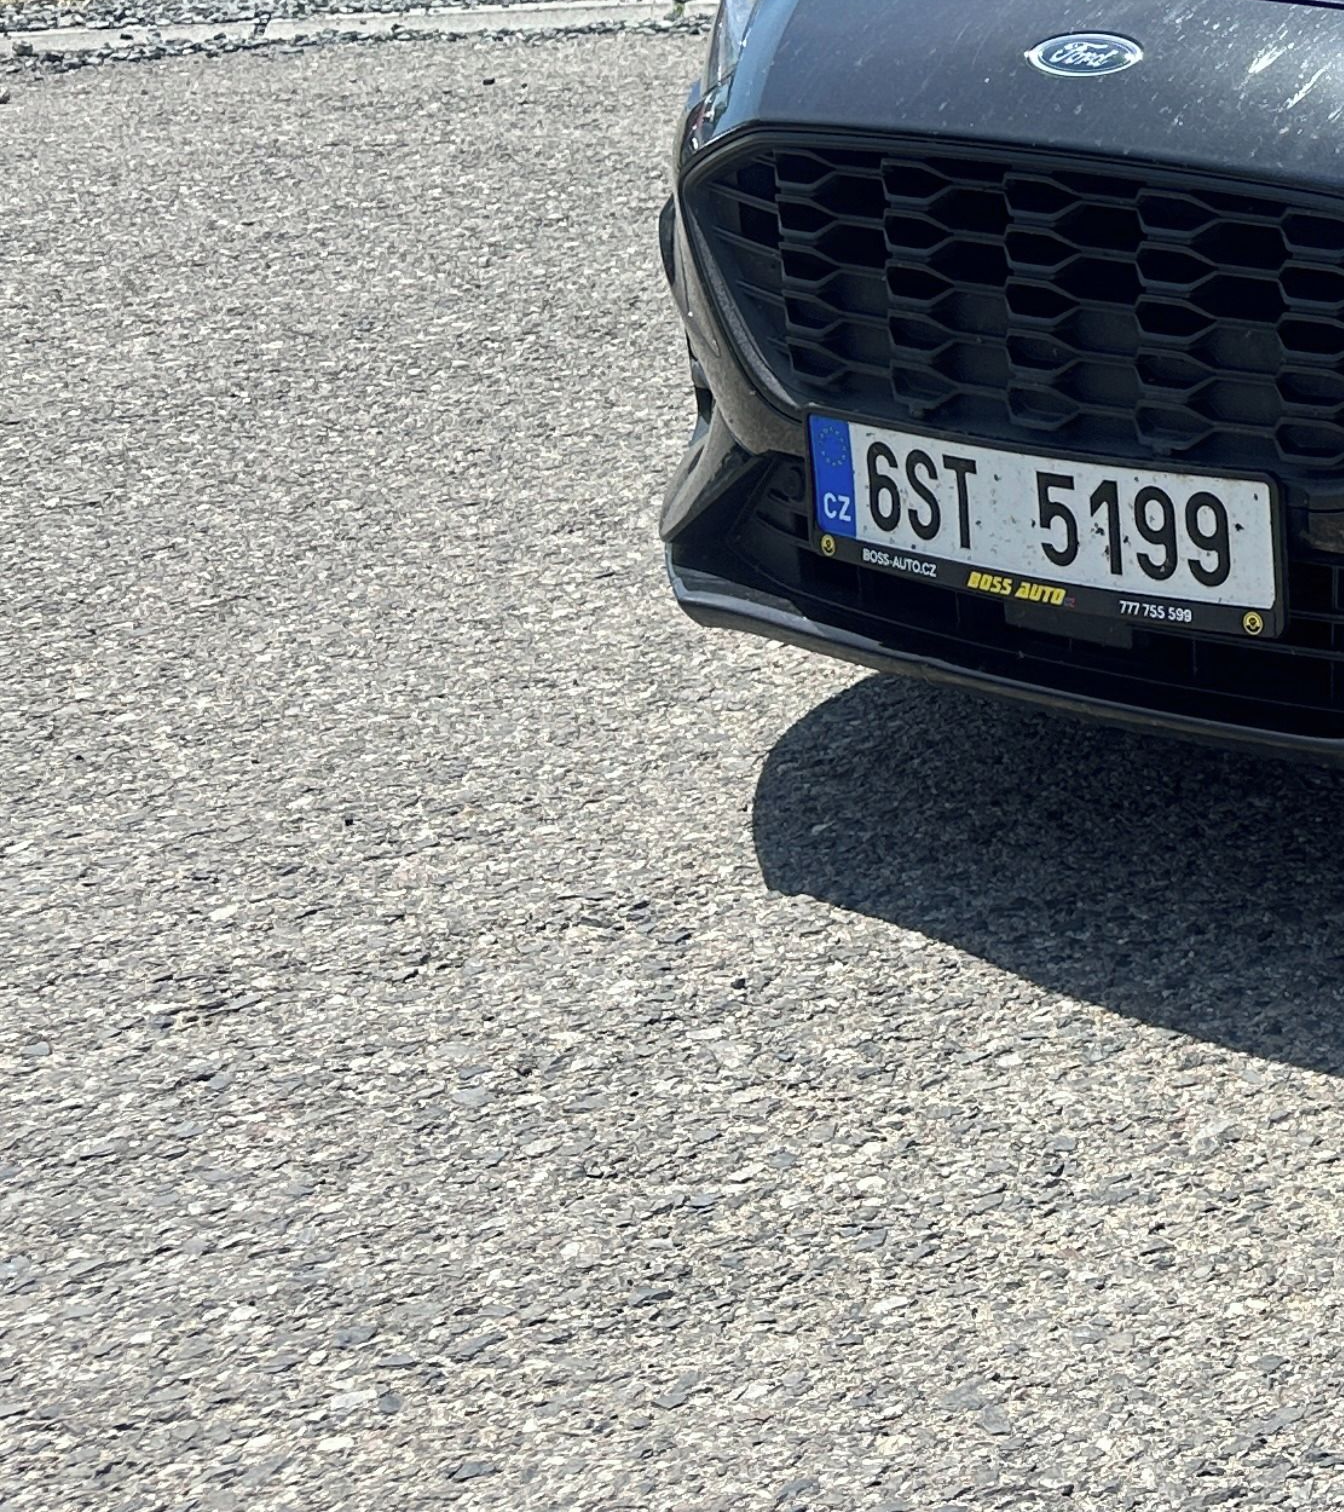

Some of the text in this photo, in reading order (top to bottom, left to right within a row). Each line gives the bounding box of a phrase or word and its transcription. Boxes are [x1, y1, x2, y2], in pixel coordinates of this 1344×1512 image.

[1049, 42, 1118, 67] Ford
[823, 491, 851, 522] CZ
[866, 440, 1231, 588] 6ST 5199
[862, 547, 937, 578] BOSS-AUTO.CZ
[967, 570, 1067, 607] BOSS AUTO
[1119, 599, 1193, 624] 777 755 599
